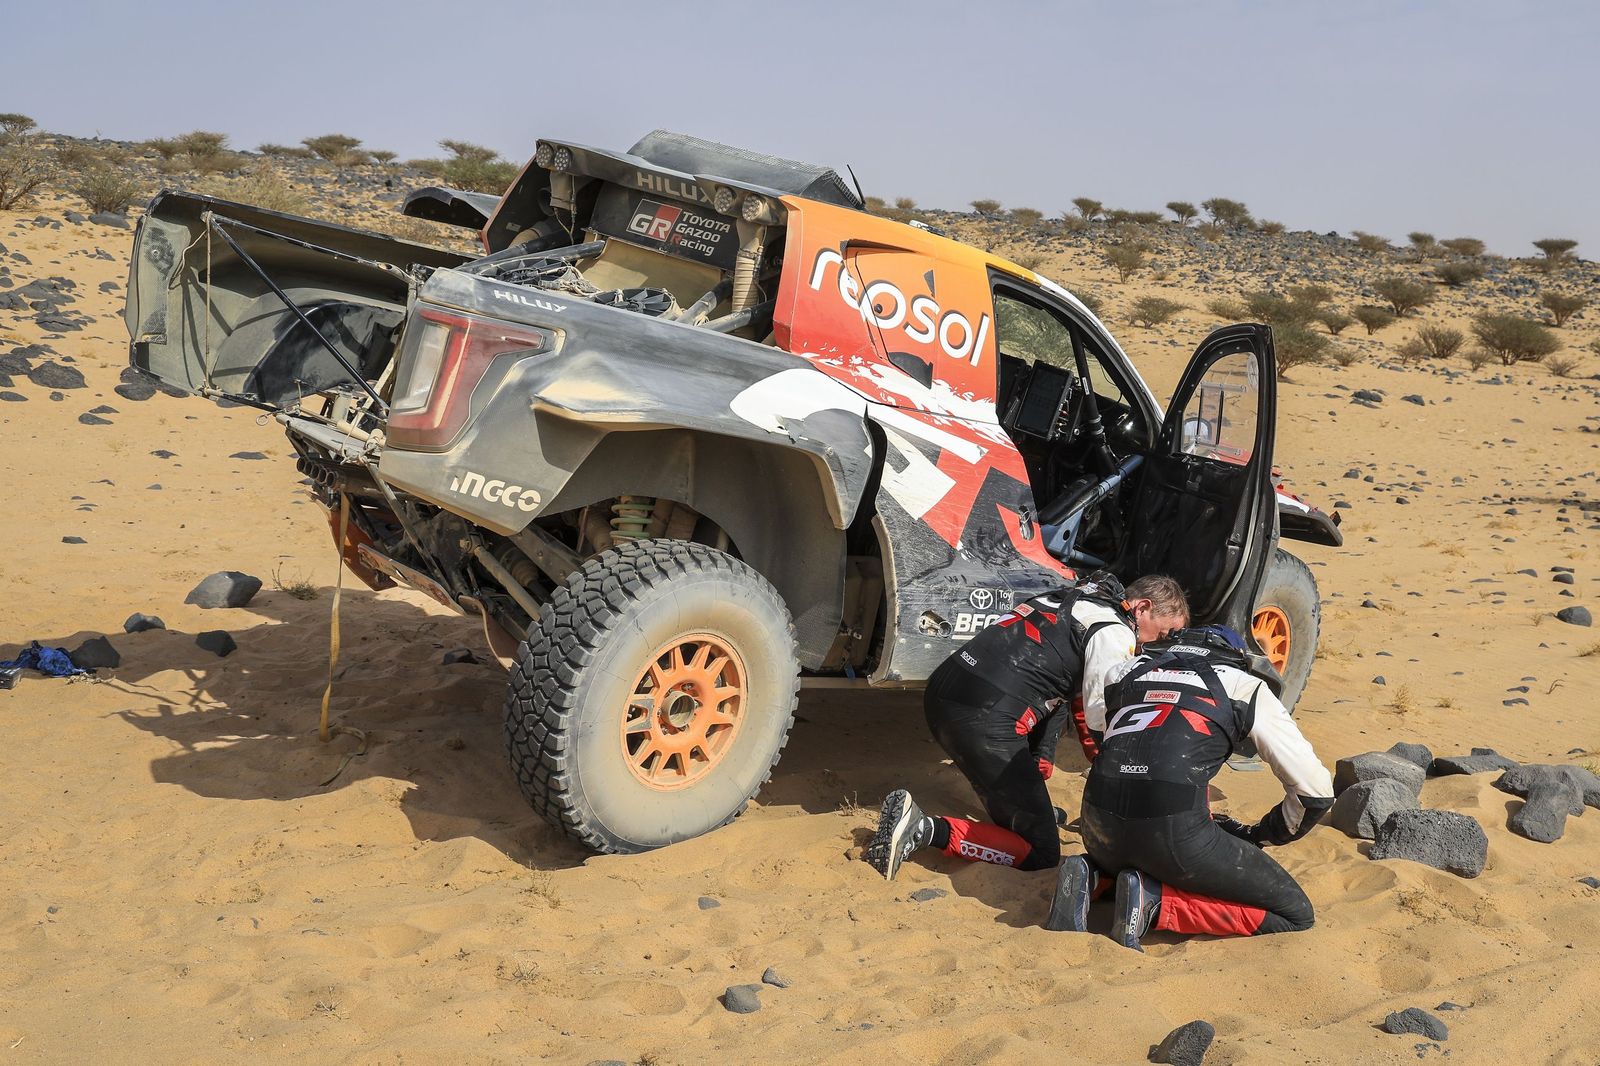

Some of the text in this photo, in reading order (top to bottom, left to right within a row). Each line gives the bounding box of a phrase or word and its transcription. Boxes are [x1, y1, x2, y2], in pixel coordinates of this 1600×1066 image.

[637, 171, 714, 205] HILUX
[630, 213, 672, 240] GR
[675, 223, 721, 244] GAZOO
[679, 211, 731, 234] TOYOTA
[671, 233, 715, 257] Racing
[493, 289, 568, 313] HILUX
[1148, 692, 1175, 700] SIMPSON
[1120, 764, 1149, 775] sparco
[960, 840, 1016, 866] sparco
[1127, 906, 1139, 936] sparco
